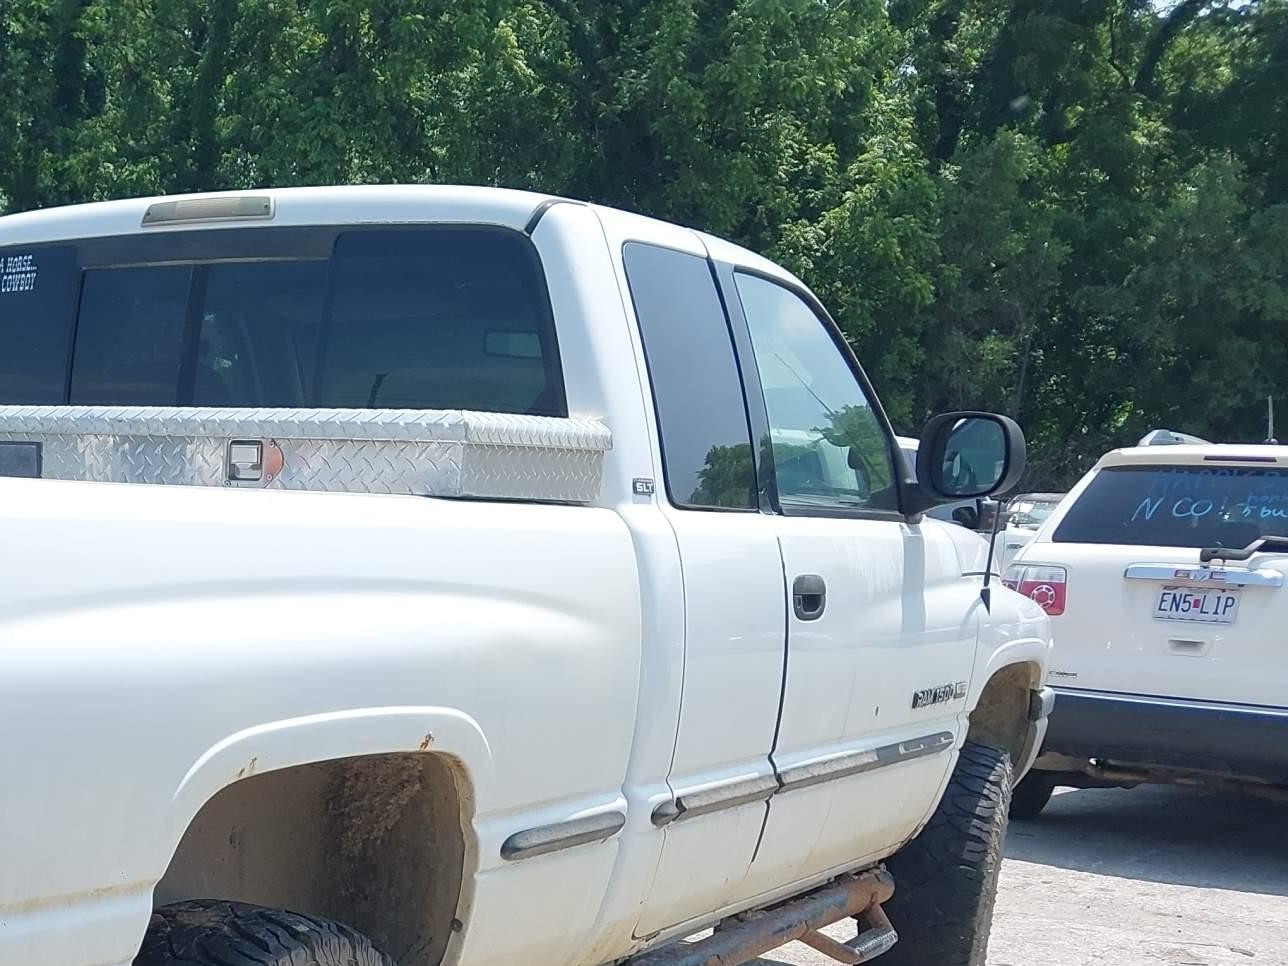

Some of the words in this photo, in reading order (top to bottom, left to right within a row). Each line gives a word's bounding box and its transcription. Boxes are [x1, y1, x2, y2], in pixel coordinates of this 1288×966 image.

[1, 272, 37, 293] COWBOY
[1174, 569, 1227, 581] GMC
[1158, 592, 1193, 613] EN5
